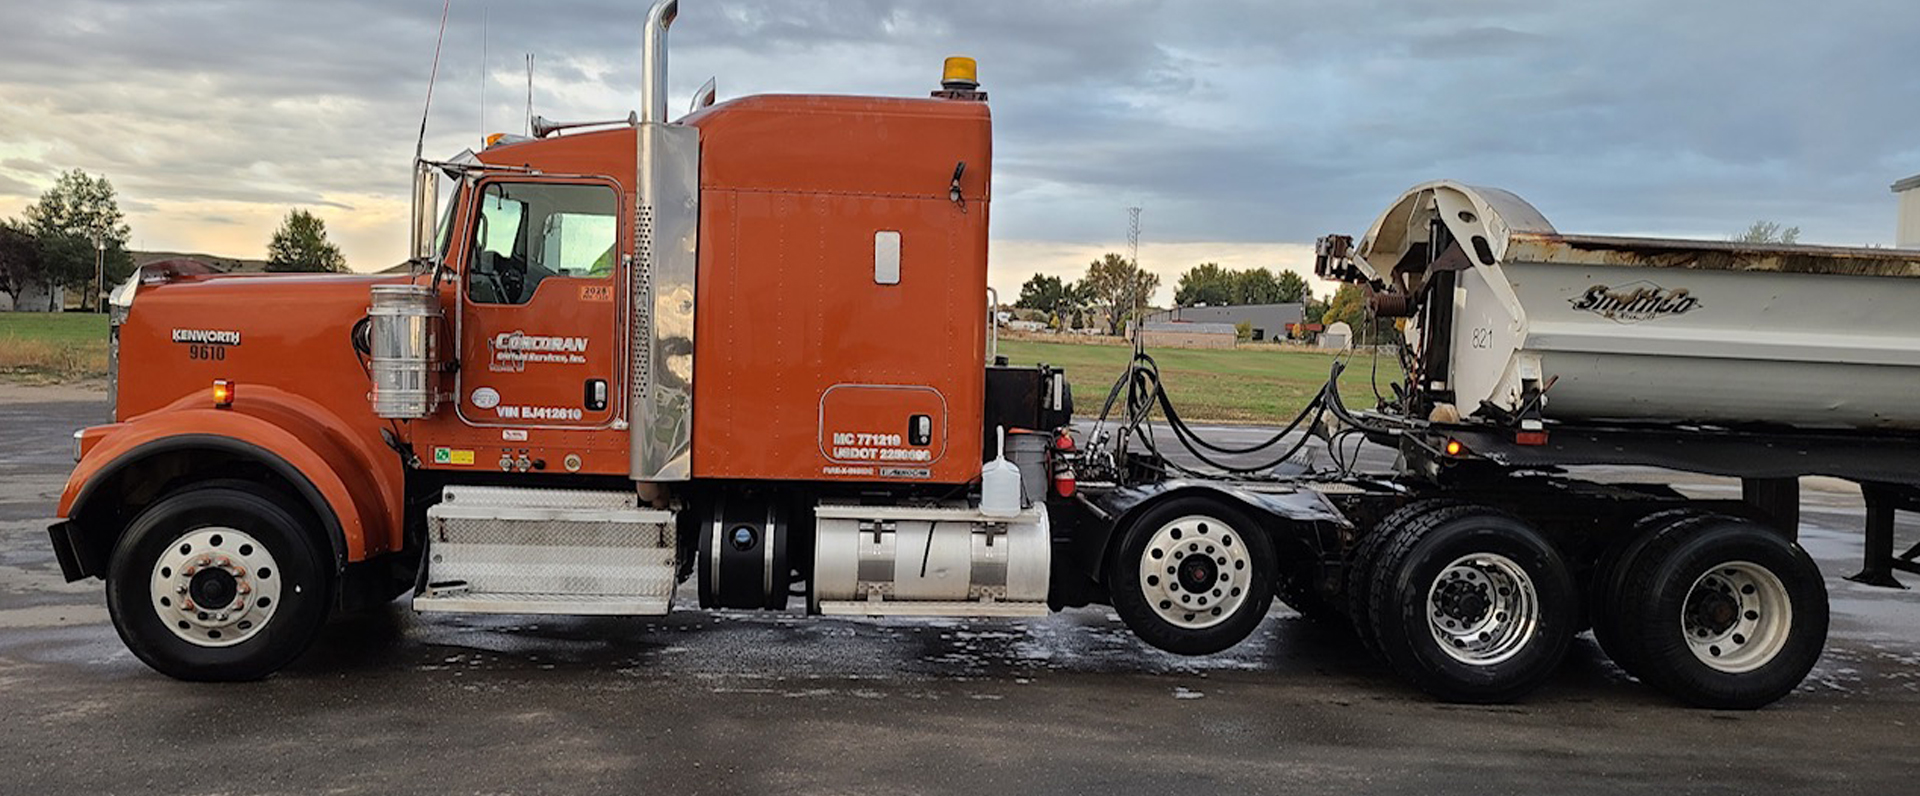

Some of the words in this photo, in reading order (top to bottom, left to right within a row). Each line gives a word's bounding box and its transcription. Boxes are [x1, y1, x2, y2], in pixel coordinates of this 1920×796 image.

[172, 328, 241, 345] KENWORTH
[495, 332, 589, 352] CORCORAN
[1472, 328, 1493, 349] 821
[190, 345, 225, 361] 9610
[496, 406, 519, 418] VIN
[833, 432, 856, 445] MC
[857, 433, 901, 446] 771219
[833, 447, 879, 459] USDOT
